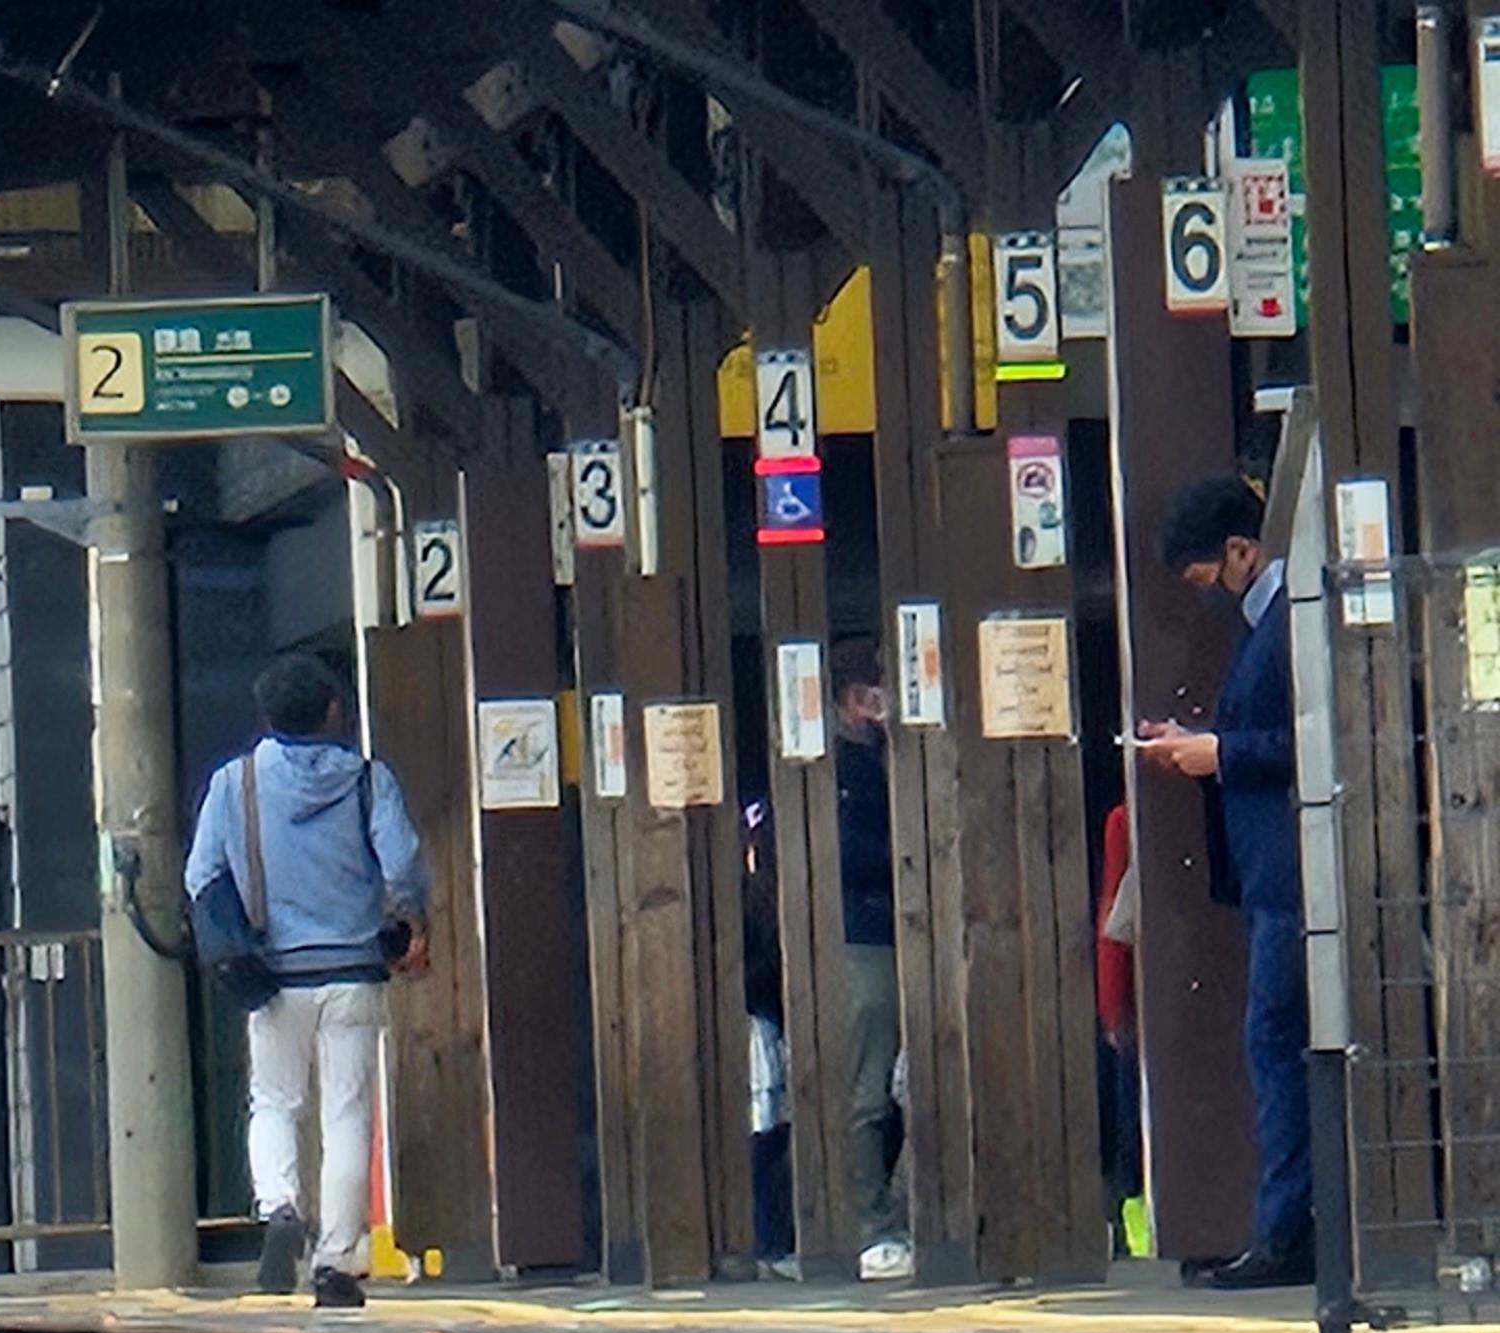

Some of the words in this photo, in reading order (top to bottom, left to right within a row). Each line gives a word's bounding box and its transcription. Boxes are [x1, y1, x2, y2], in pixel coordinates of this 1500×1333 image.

[1170, 201, 1221, 293] 6
[1004, 255, 1049, 341] 5
[91, 345, 125, 399] 2
[765, 370, 806, 446] 4
[580, 460, 617, 528] 3
[421, 538, 455, 601] 2
